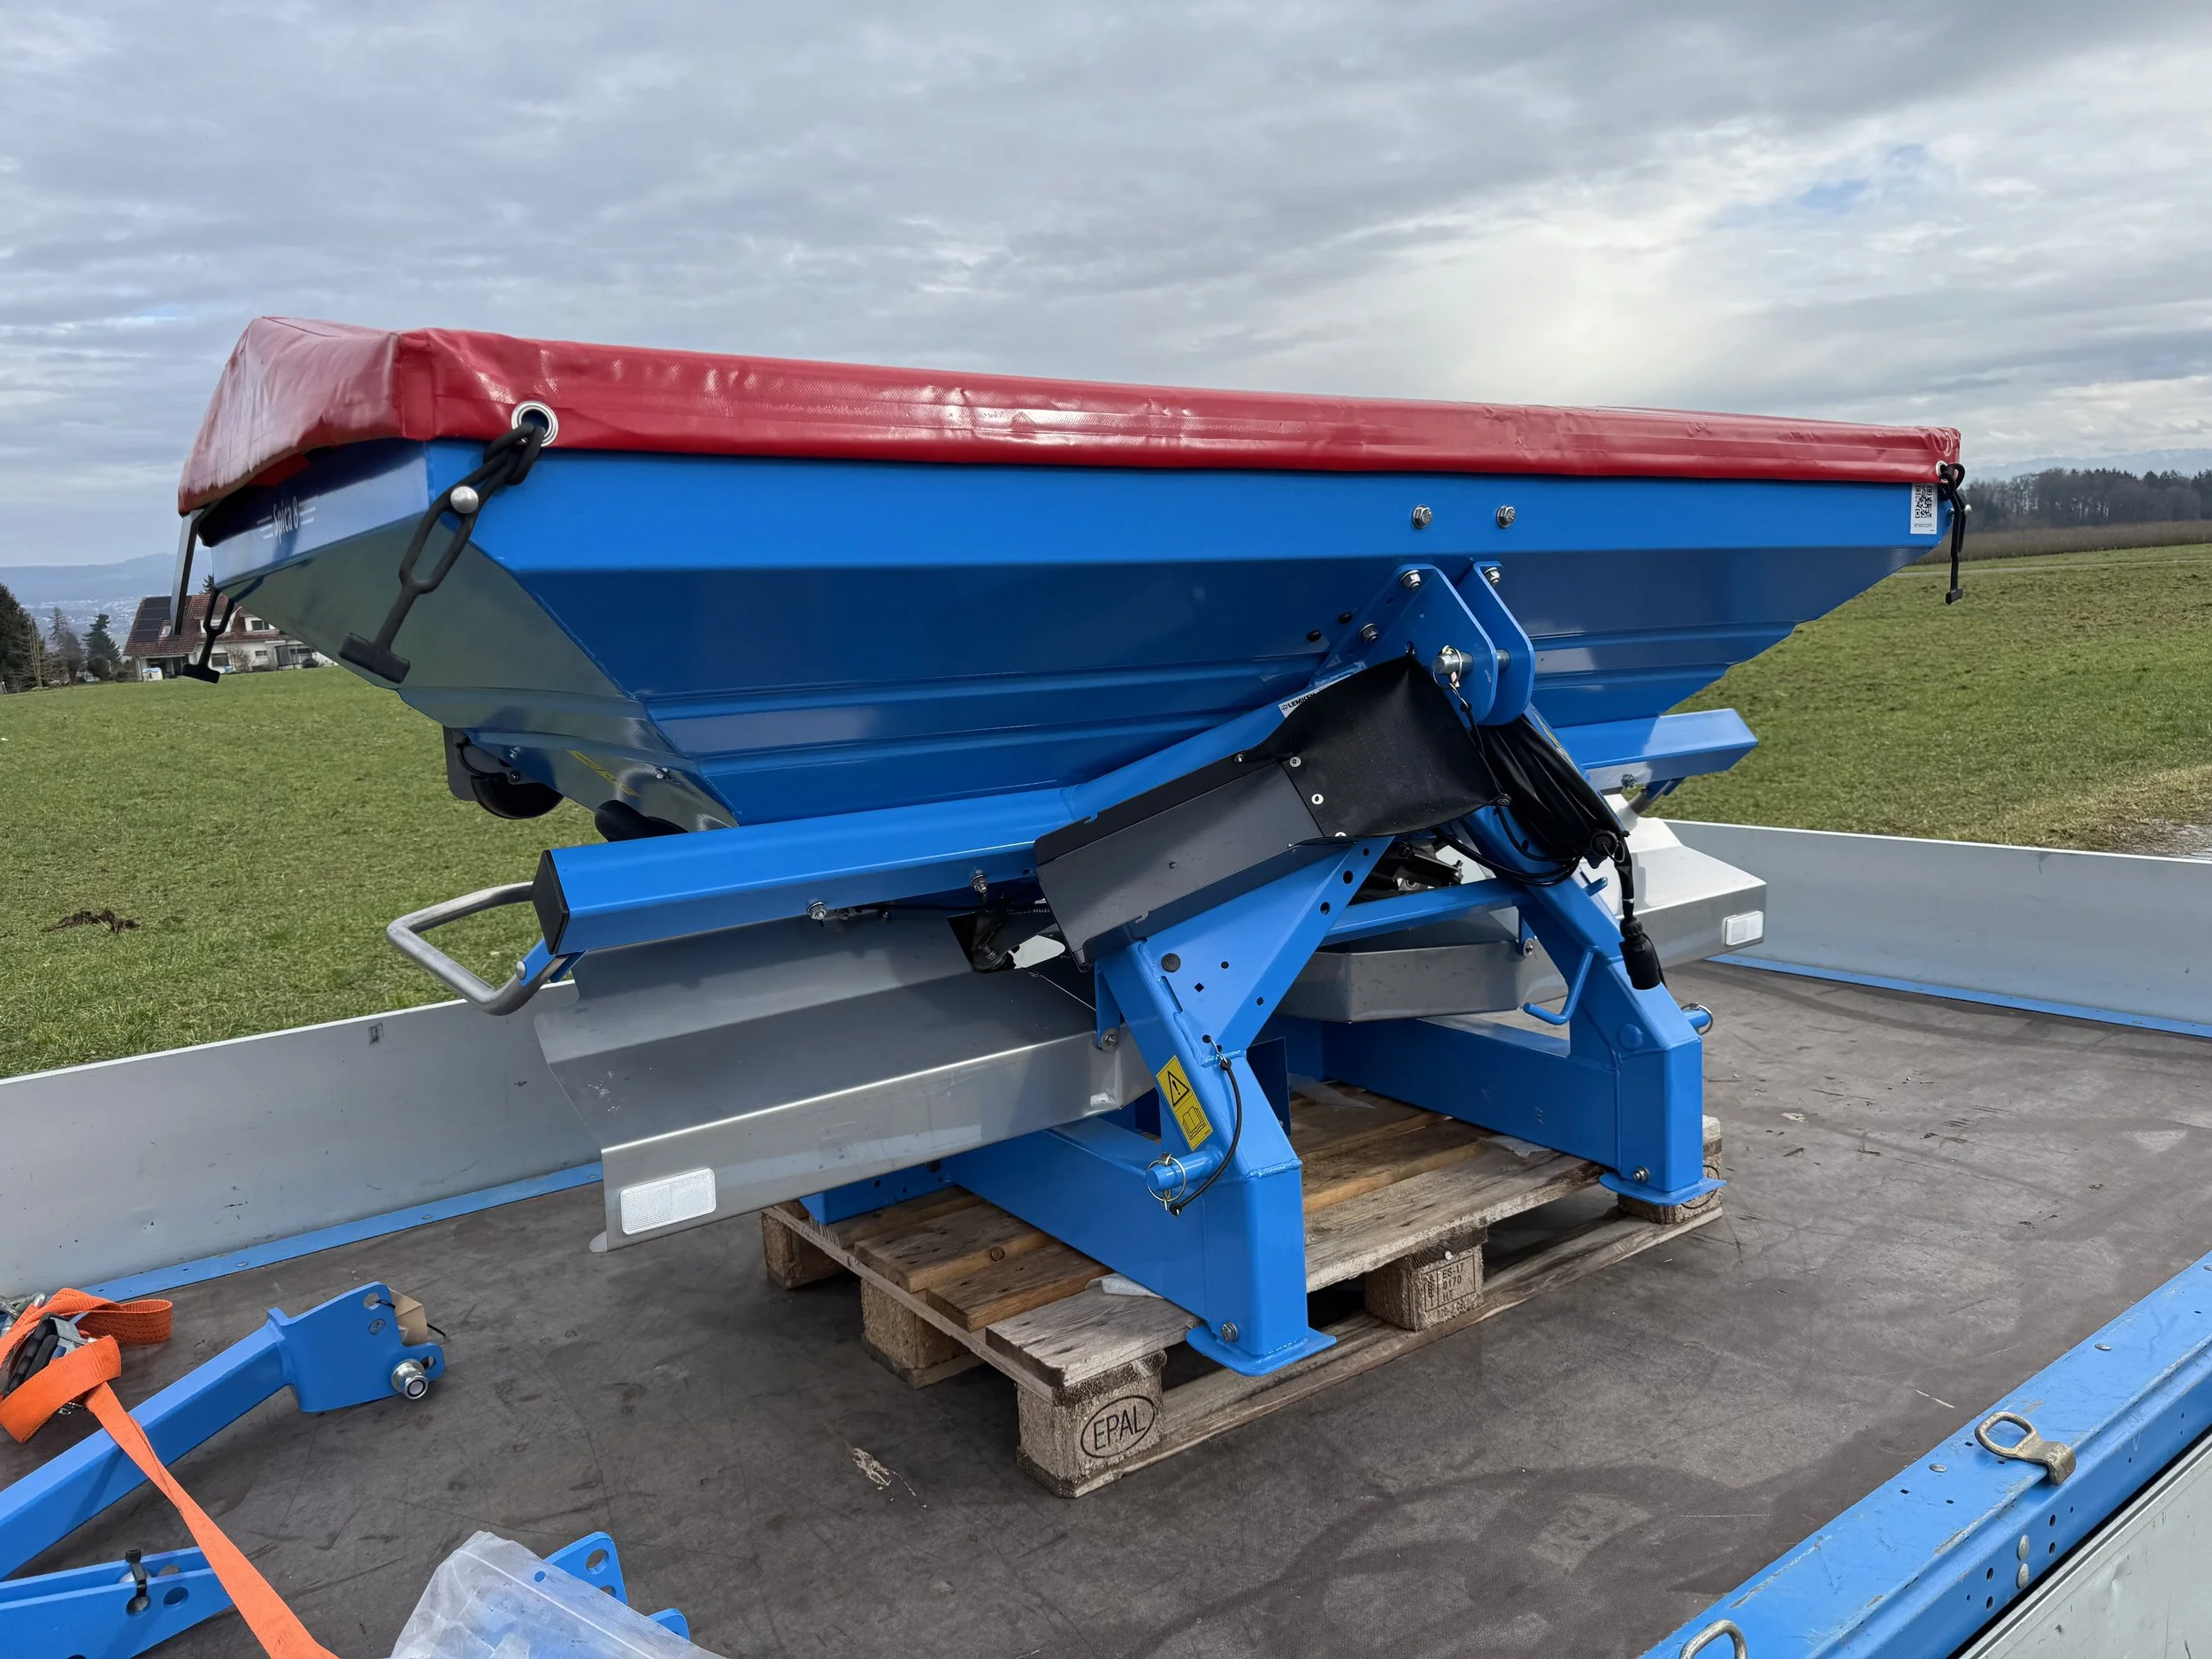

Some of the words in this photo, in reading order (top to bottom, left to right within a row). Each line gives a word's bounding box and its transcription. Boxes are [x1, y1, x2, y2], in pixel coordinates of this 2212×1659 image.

[273, 499, 293, 544] Spica
[292, 495, 299, 529] 8
[1442, 1274, 1462, 1290] 0170
[1093, 1405, 1147, 1451] EPAL
